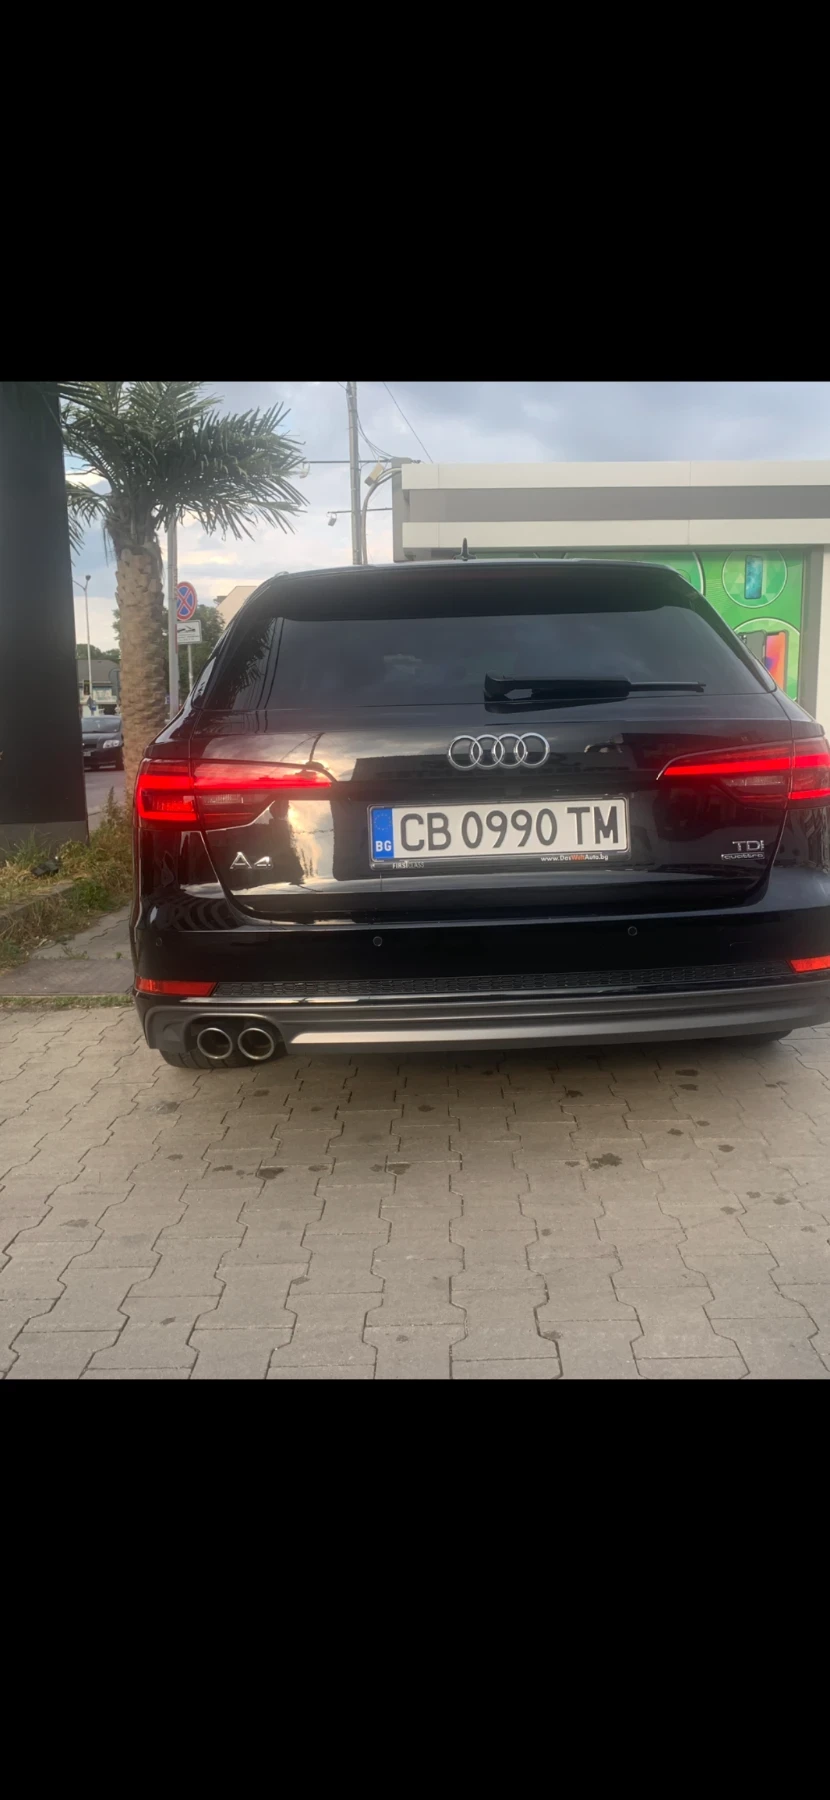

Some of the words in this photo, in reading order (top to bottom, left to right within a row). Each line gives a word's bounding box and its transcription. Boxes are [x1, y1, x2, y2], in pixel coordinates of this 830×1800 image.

[400, 812, 452, 852] CB
[461, 808, 558, 849] 0990
[566, 805, 619, 845] TM
[375, 840, 392, 852] BG
[732, 840, 765, 851] TDI
[230, 851, 273, 869] A4
[723, 852, 764, 860] quattro
